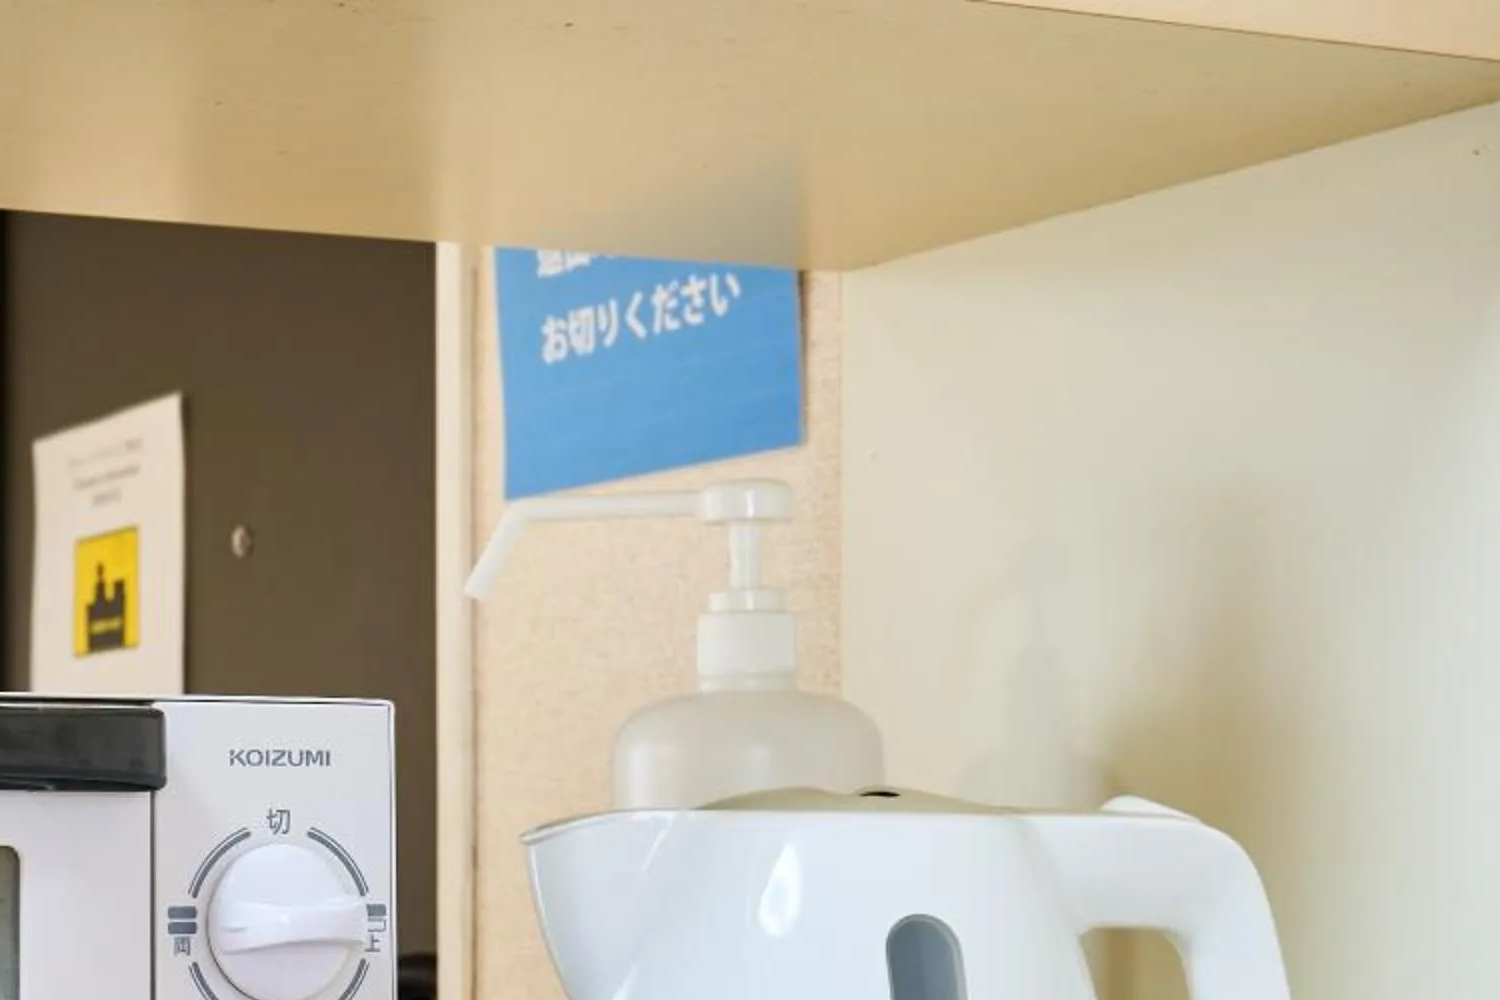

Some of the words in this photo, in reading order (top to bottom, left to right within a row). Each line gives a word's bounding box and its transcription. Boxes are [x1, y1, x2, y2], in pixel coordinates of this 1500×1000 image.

[541, 272, 742, 365] お切りください
[229, 749, 332, 767] KOIZUMI
[266, 808, 291, 835] 切
